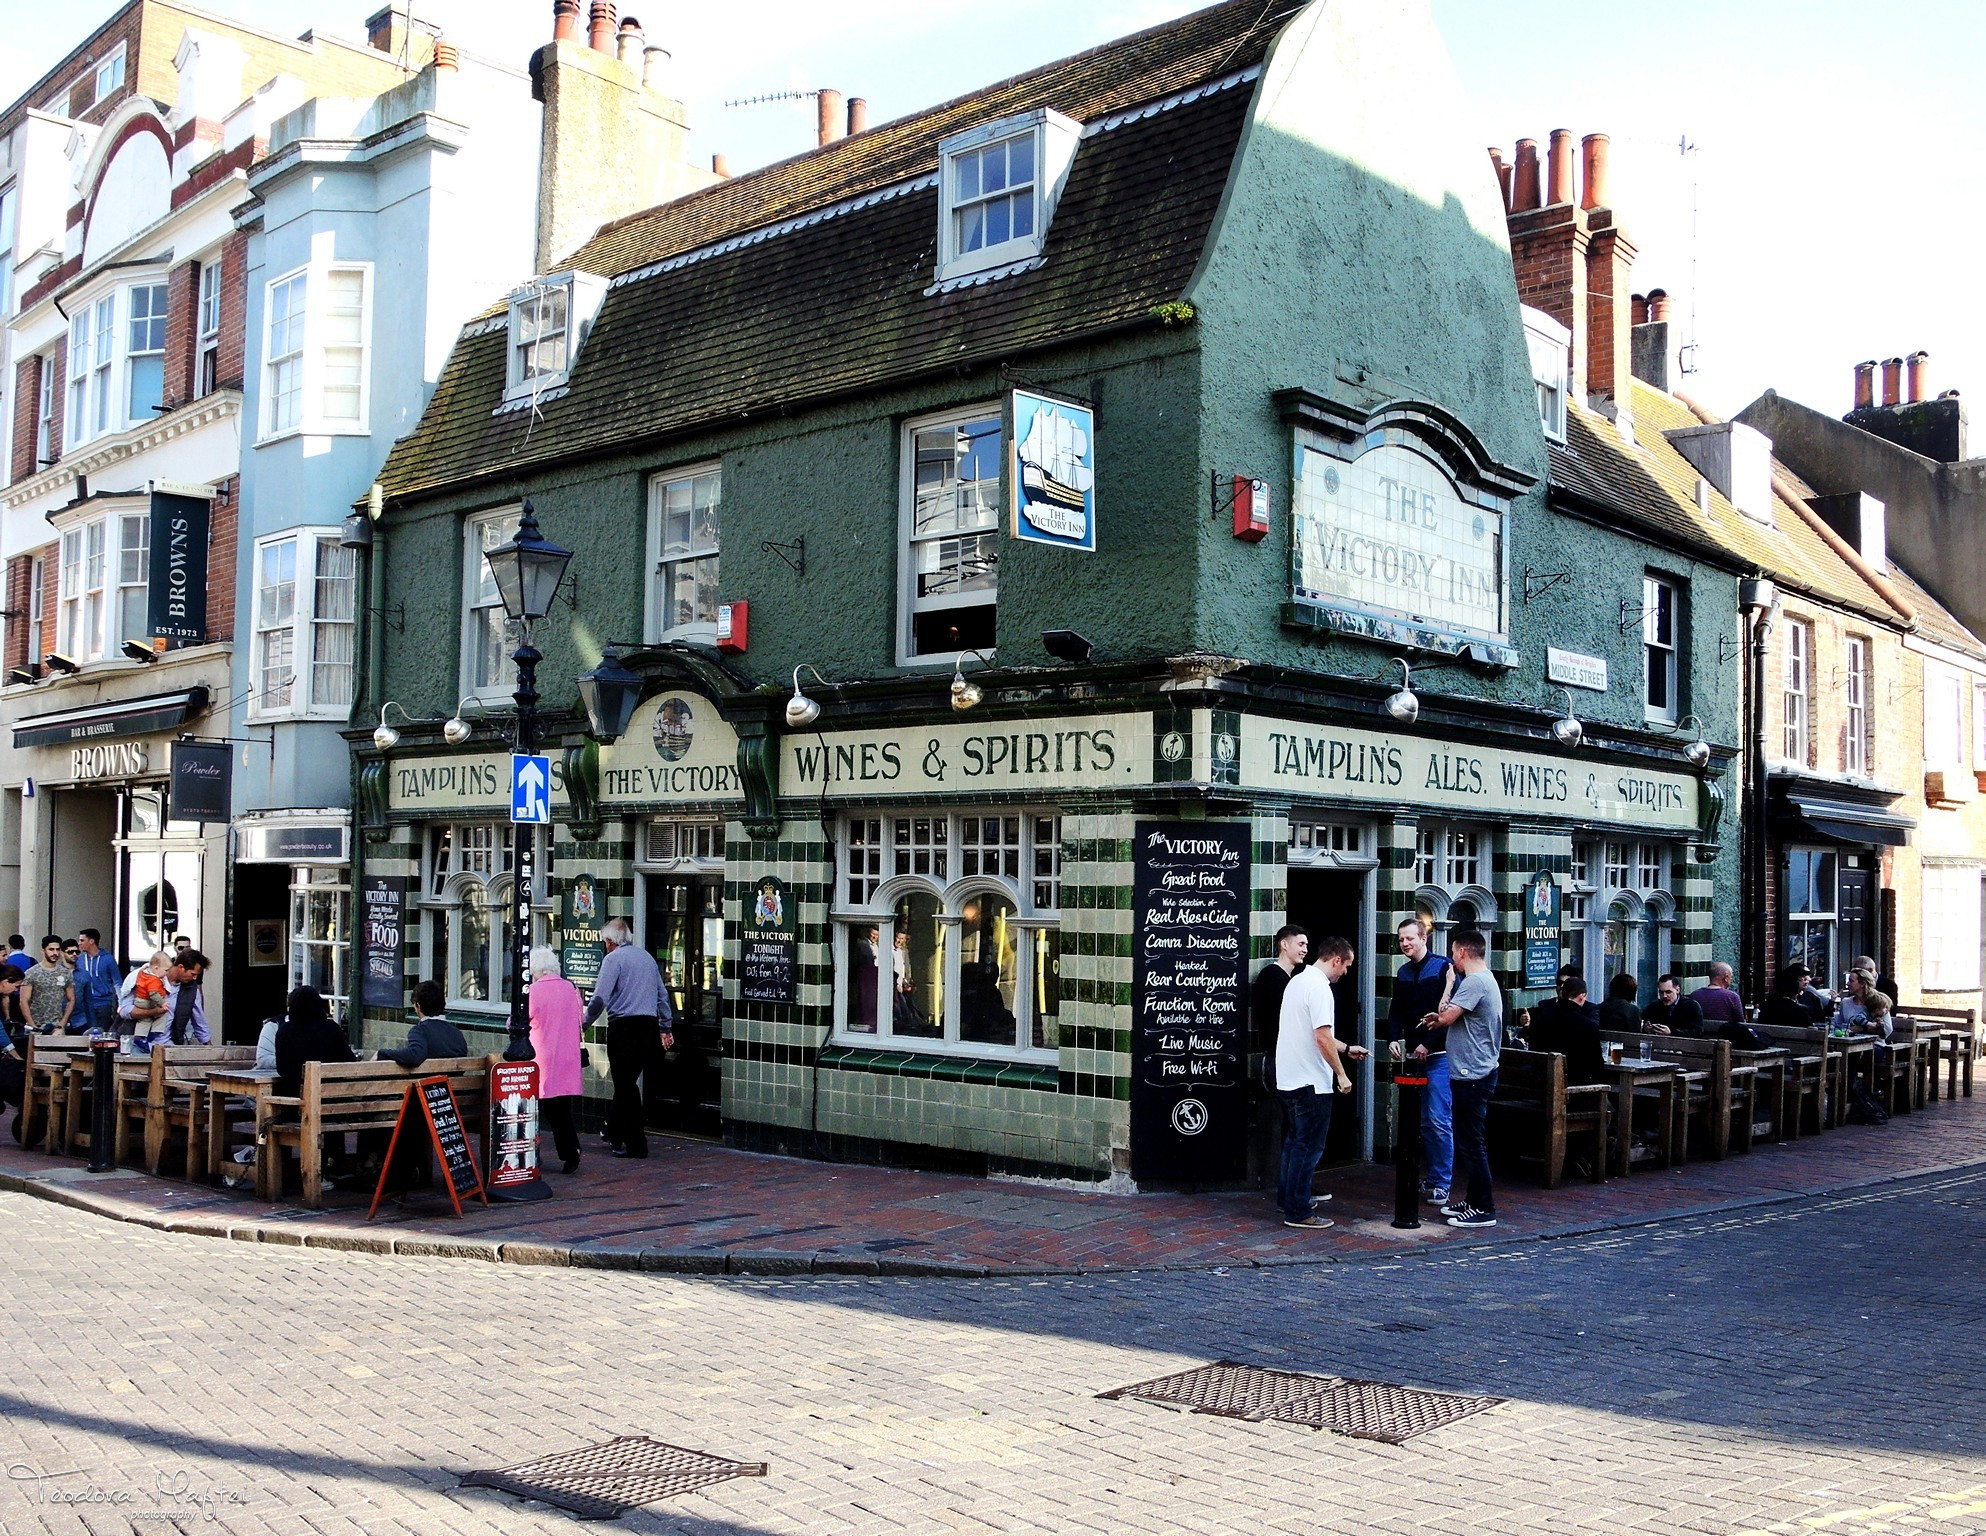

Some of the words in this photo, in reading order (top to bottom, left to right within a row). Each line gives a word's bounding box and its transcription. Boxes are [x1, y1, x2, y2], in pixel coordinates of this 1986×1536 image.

[1379, 476, 1438, 532] THE
[1048, 508, 1066, 521] THE
[1031, 514, 1066, 531] VICTORY
[1069, 521, 1085, 532] INN
[169, 518, 189, 618] BROWNS
[155, 626, 175, 635] EST.
[177, 629, 198, 637] 1973
[1551, 662, 1577, 680] MIDDLE
[1579, 669, 1605, 686] STREET
[70, 728, 81, 737] BAR
[81, 726, 86, 736] &
[87, 722, 115, 736] BRASSERIE
[71, 741, 141, 779] BROWNS
[181, 760, 221, 775] Powder
[794, 742, 901, 782] WINES
[922, 738, 948, 781] &
[1267, 732, 1403, 785] TAMPLIN'S
[1500, 762, 1567, 802] WINES
[1585, 773, 1600, 809] &
[604, 769, 643, 794] THE
[1147, 831, 1166, 848] The
[1164, 839, 1224, 855] VICTORY
[1220, 849, 1239, 862] Inn
[377, 880, 387, 890] The
[1162, 871, 1197, 890] Great
[1199, 871, 1226, 888] Food
[365, 890, 388, 902] VICTORY
[389, 891, 399, 902] INN
[1162, 898, 1177, 907] Wide
[1178, 898, 1206, 907] Selection
[1207, 899, 1217, 907] of
[1145, 909, 1175, 925] Real
[1176, 909, 1202, 925] Ales
[1208, 909, 1239, 924] Cider
[371, 922, 399, 948] FOOD
[744, 931, 759, 939] THE
[761, 931, 794, 941] VICTORY
[1525, 927, 1559, 939] VICTORY
[753, 944, 784, 955] TONIGHT
[1145, 934, 1182, 949] Camra
[1186, 934, 1238, 949] Discounts
[369, 959, 393, 976] SPECIALS
[759, 963, 772, 977] from
[1174, 961, 1208, 971] Heated
[1145, 971, 1173, 987] Rear
[1175, 972, 1238, 993] Courtyard
[1143, 996, 1197, 1014] Function
[1202, 998, 1237, 1013] Room
[1156, 1013, 1191, 1024] Available
[1195, 1013, 1207, 1024] for
[1209, 1014, 1224, 1025] Hire
[1159, 1035, 1185, 1050] Live
[1188, 1035, 1223, 1050] Music
[1162, 1060, 1187, 1076] Free
[1190, 1060, 1218, 1075] Wi-fi
